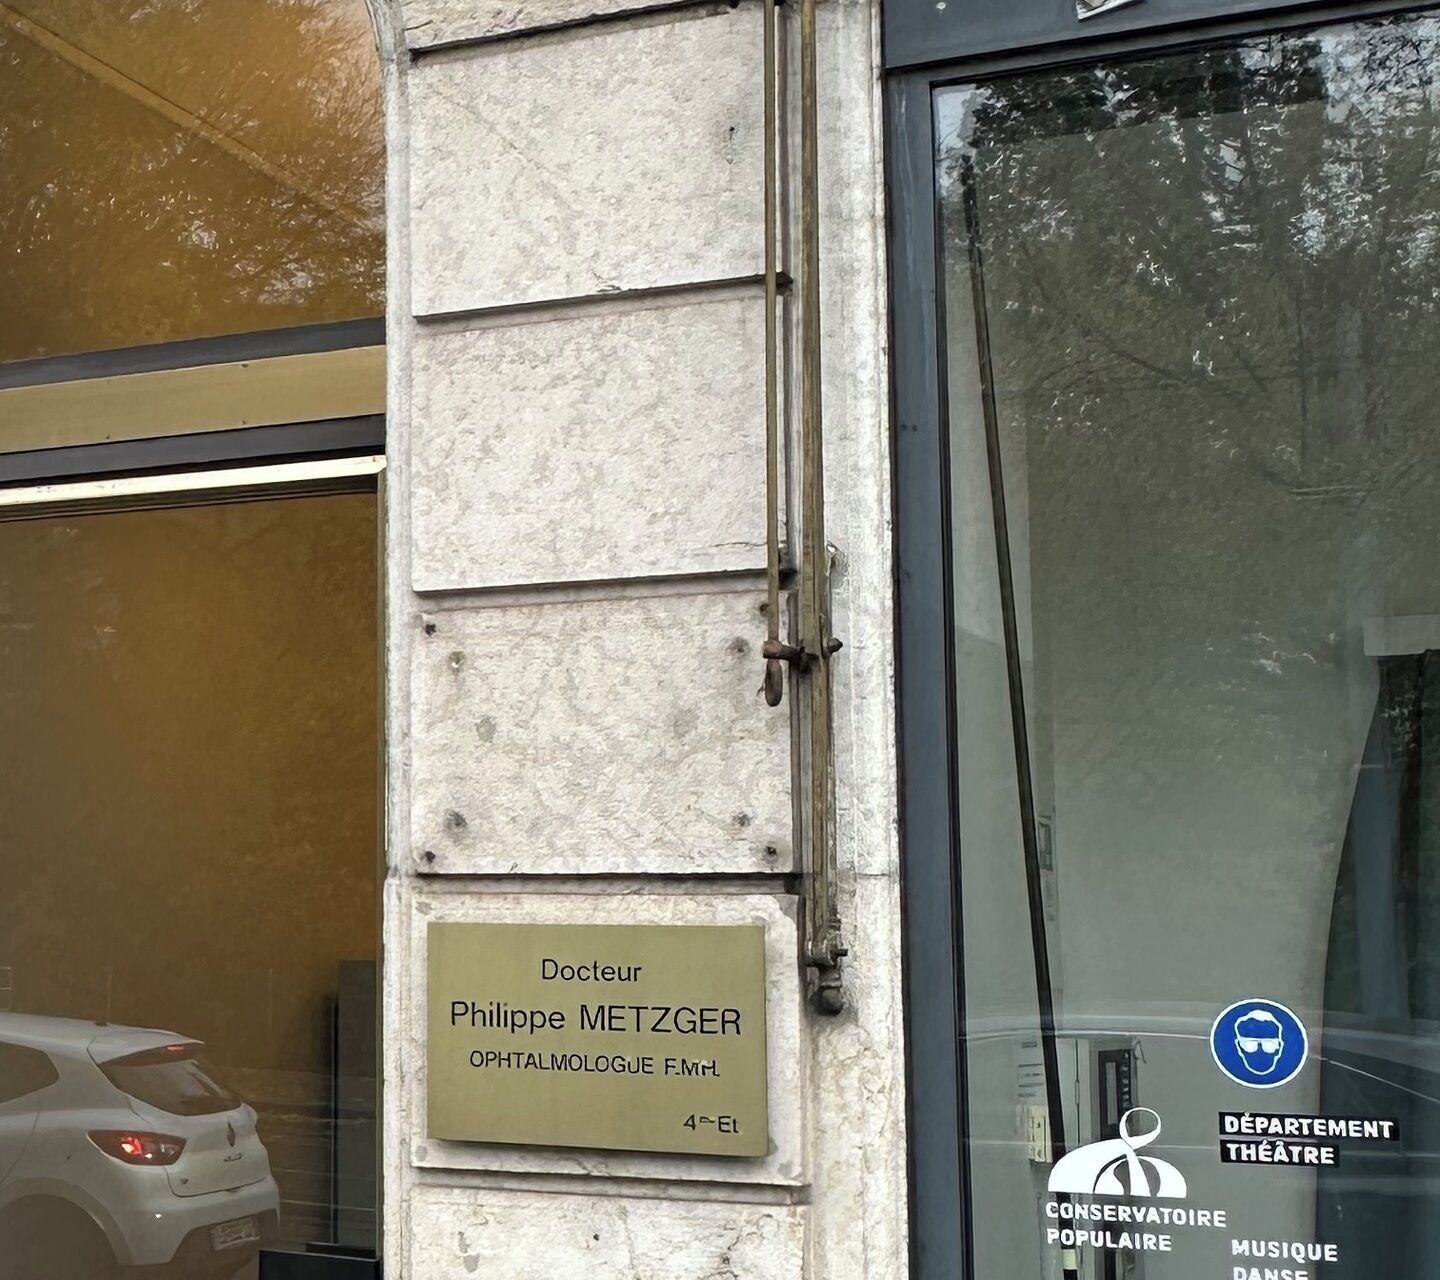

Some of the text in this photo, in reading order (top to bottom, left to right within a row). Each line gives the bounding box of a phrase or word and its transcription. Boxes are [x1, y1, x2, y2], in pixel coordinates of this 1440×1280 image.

[541, 958, 642, 982] Docteur
[451, 1001, 741, 1035] Philippe METZGER
[469, 1050, 654, 1075] OPHTALMOLOGUE
[1224, 1112, 1394, 1140] DÉPARTEMENT
[1226, 1140, 1335, 1165] THÉÂTRE
[1045, 1201, 1227, 1228] CONSERVATOIRE
[1046, 1227, 1172, 1253] POPULAIRE
[1231, 1238, 1338, 1263] MUSIQUE
